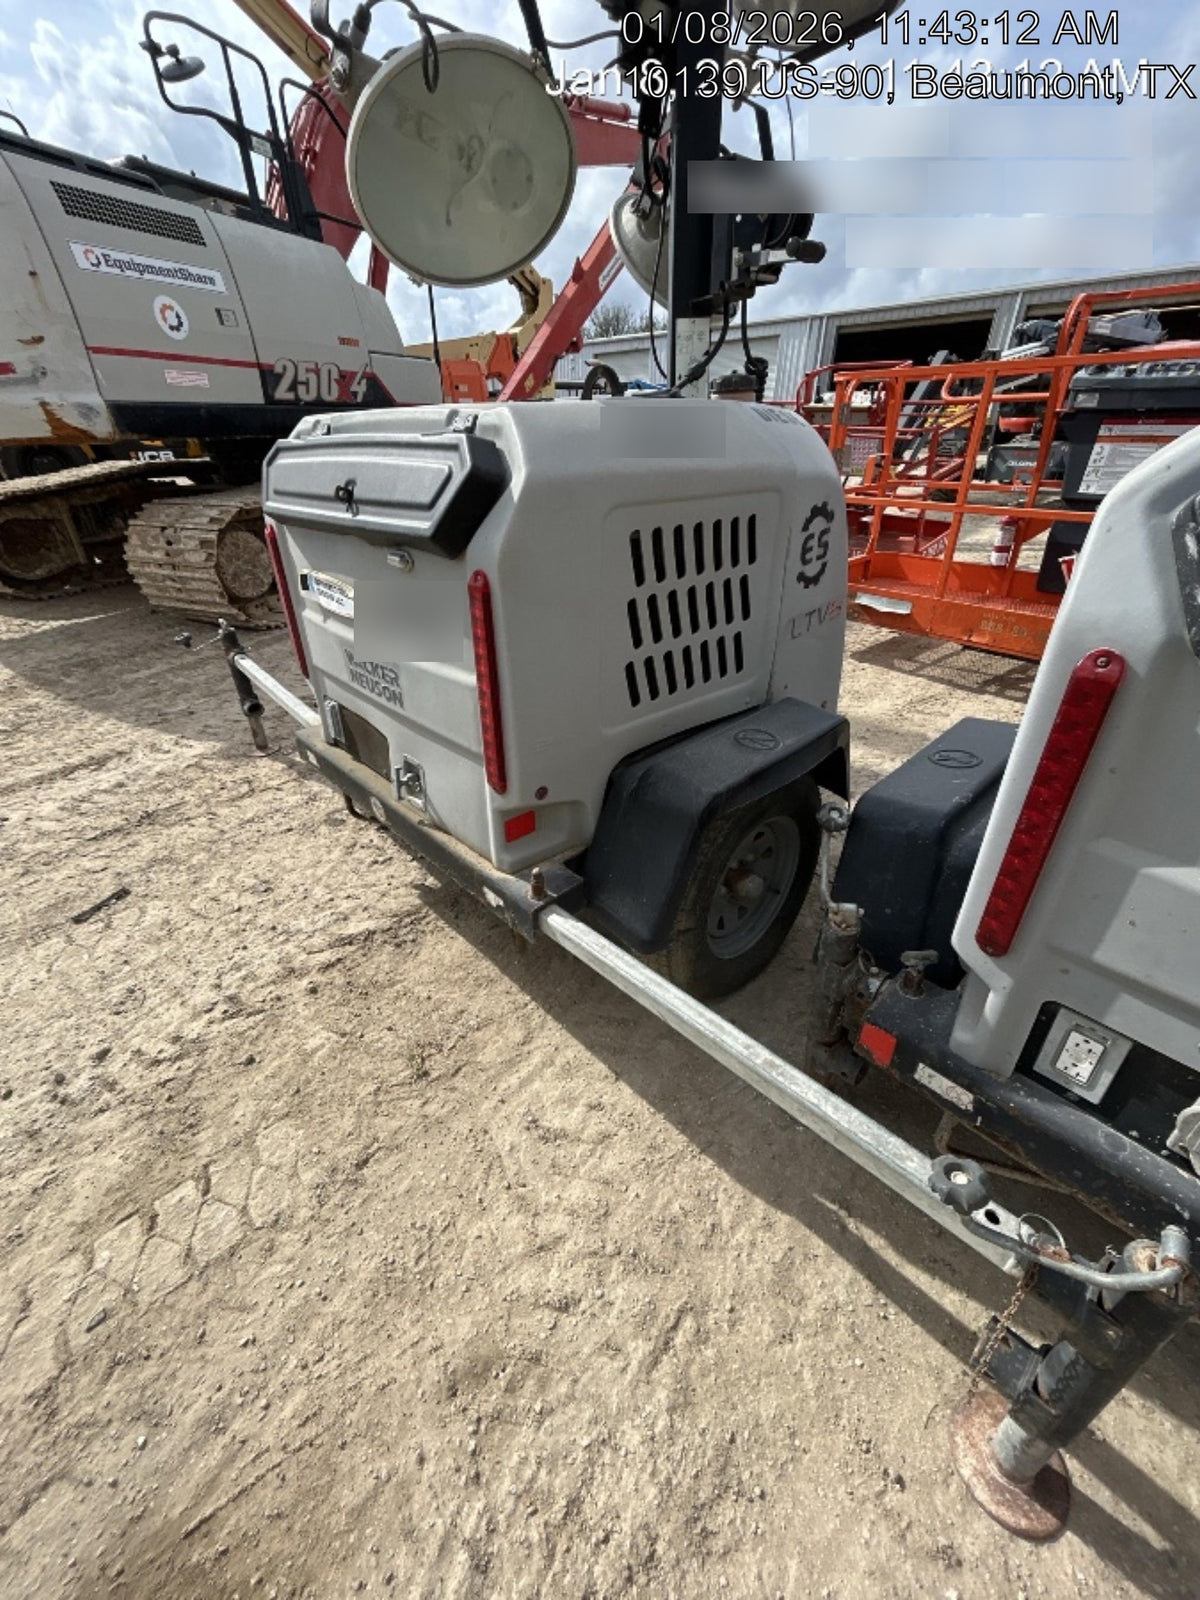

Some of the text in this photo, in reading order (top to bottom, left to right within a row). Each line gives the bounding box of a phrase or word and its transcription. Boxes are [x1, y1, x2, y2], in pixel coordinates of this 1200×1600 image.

[101, 253, 216, 286] EquipmentShare
[274, 357, 340, 402] 250
[801, 526, 832, 566] ES
[349, 669, 405, 709] NEUSON
